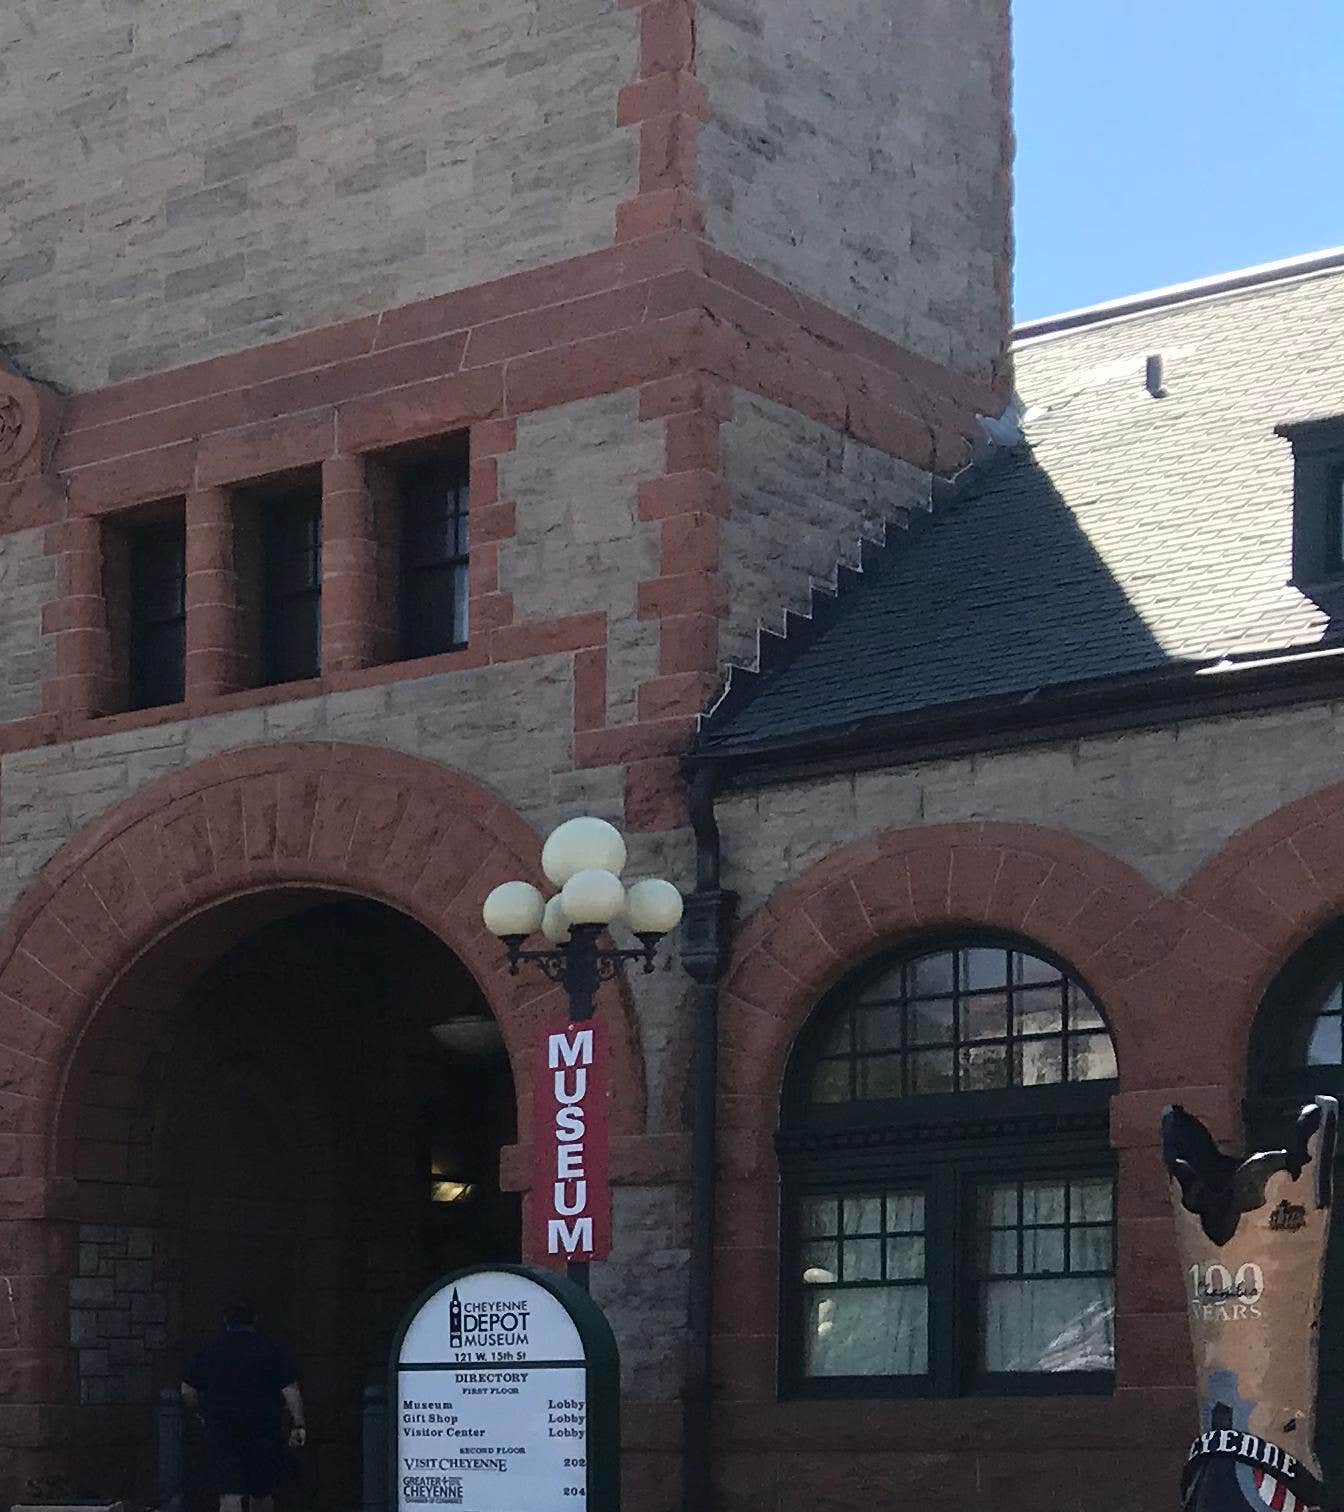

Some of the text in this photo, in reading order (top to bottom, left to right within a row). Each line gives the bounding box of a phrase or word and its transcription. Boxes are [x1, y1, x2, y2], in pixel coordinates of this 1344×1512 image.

[548, 1030, 594, 1254] MUSEUM
[463, 1301, 528, 1313] CHEYENNE
[463, 1312, 530, 1332] DEPOT
[464, 1333, 529, 1347] MUSEUM
[455, 1352, 526, 1362] 121 W. 15th St
[455, 1373, 528, 1383] DIRECTORY
[403, 1401, 453, 1410] Museum
[548, 1400, 585, 1411] Lobby
[403, 1414, 458, 1425] Gift Shop
[548, 1414, 585, 1425] Lobby
[403, 1428, 486, 1437] Visitor Center
[548, 1428, 585, 1439] Lobby
[403, 1458, 508, 1472] VISIT CHEYENNE
[564, 1459, 586, 1467] 202
[403, 1477, 441, 1486] GREATER
[403, 1485, 463, 1498] CHEYENNE
[563, 1488, 585, 1496] 204
